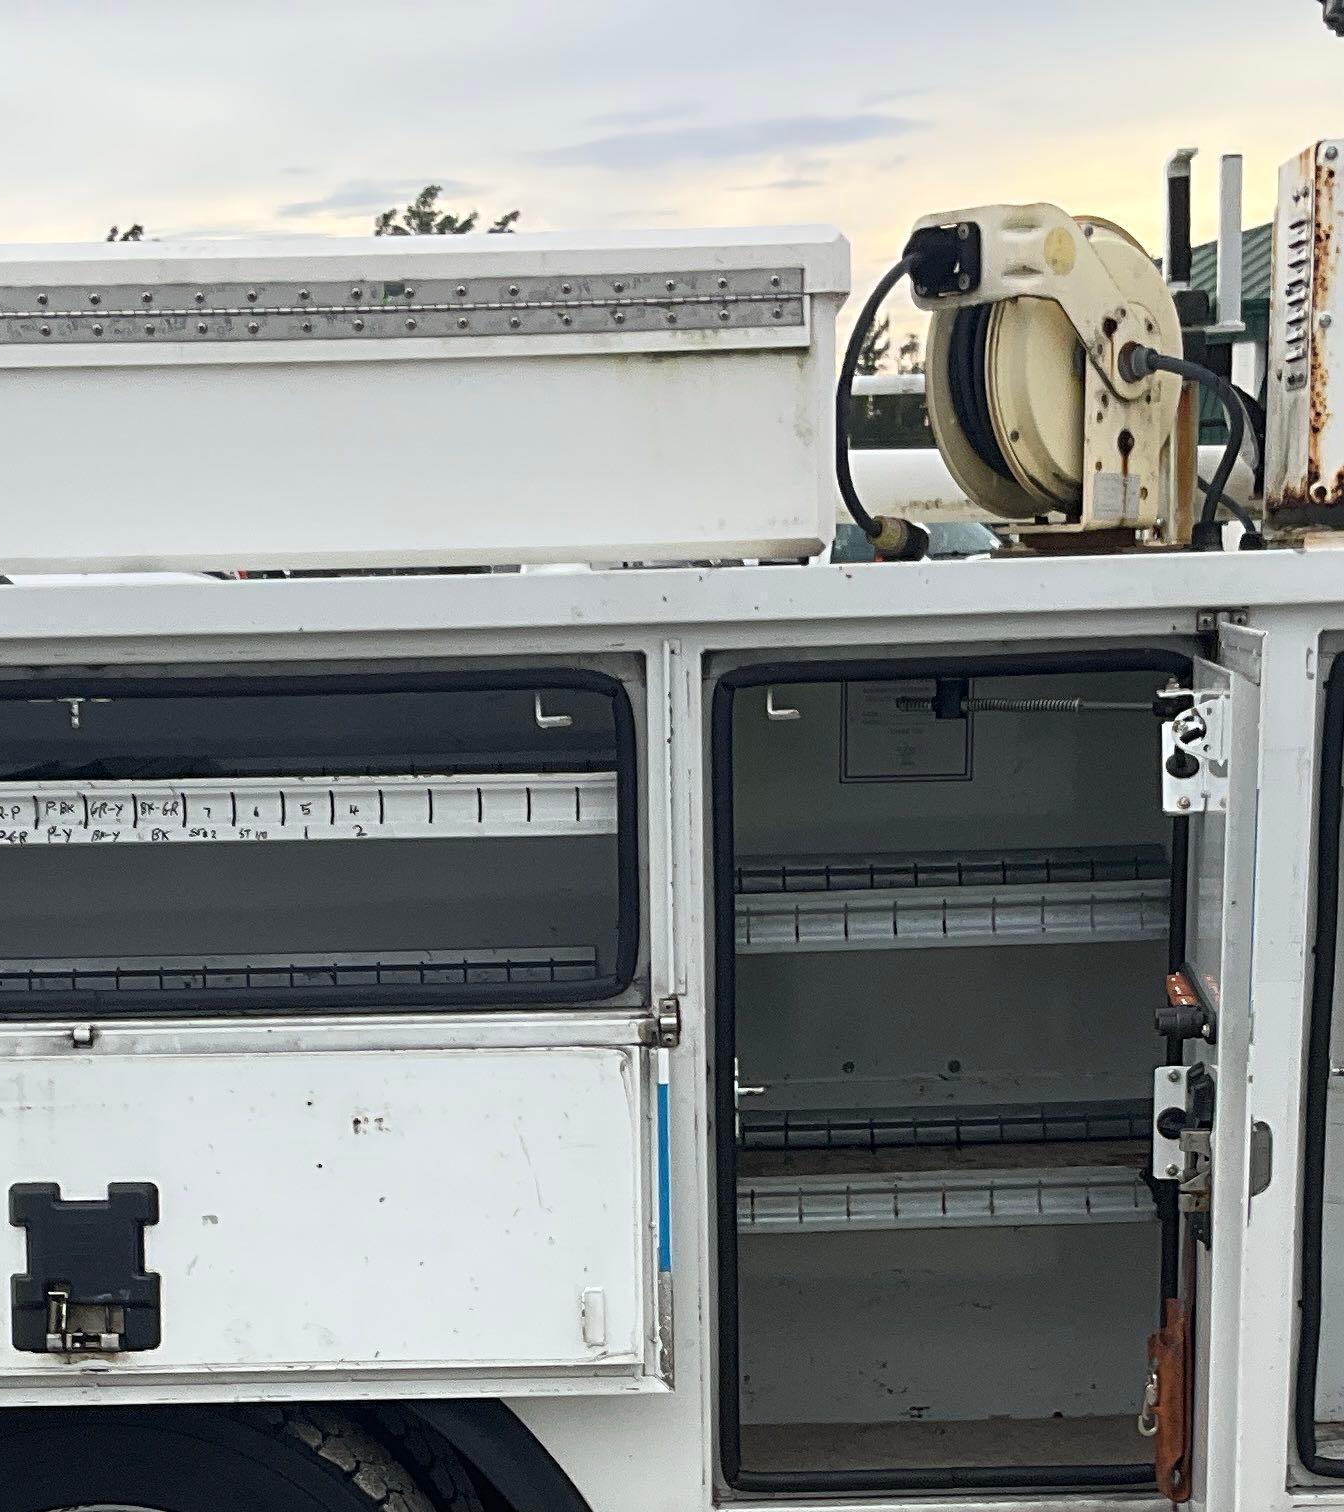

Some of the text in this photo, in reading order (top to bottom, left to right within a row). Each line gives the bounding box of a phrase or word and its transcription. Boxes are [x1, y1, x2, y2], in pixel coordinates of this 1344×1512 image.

[300, 802, 312, 816] 5
[350, 804, 359, 816] 4
[48, 826, 72, 843] P-Y
[151, 828, 172, 841] BK
[352, 824, 367, 838] 2
